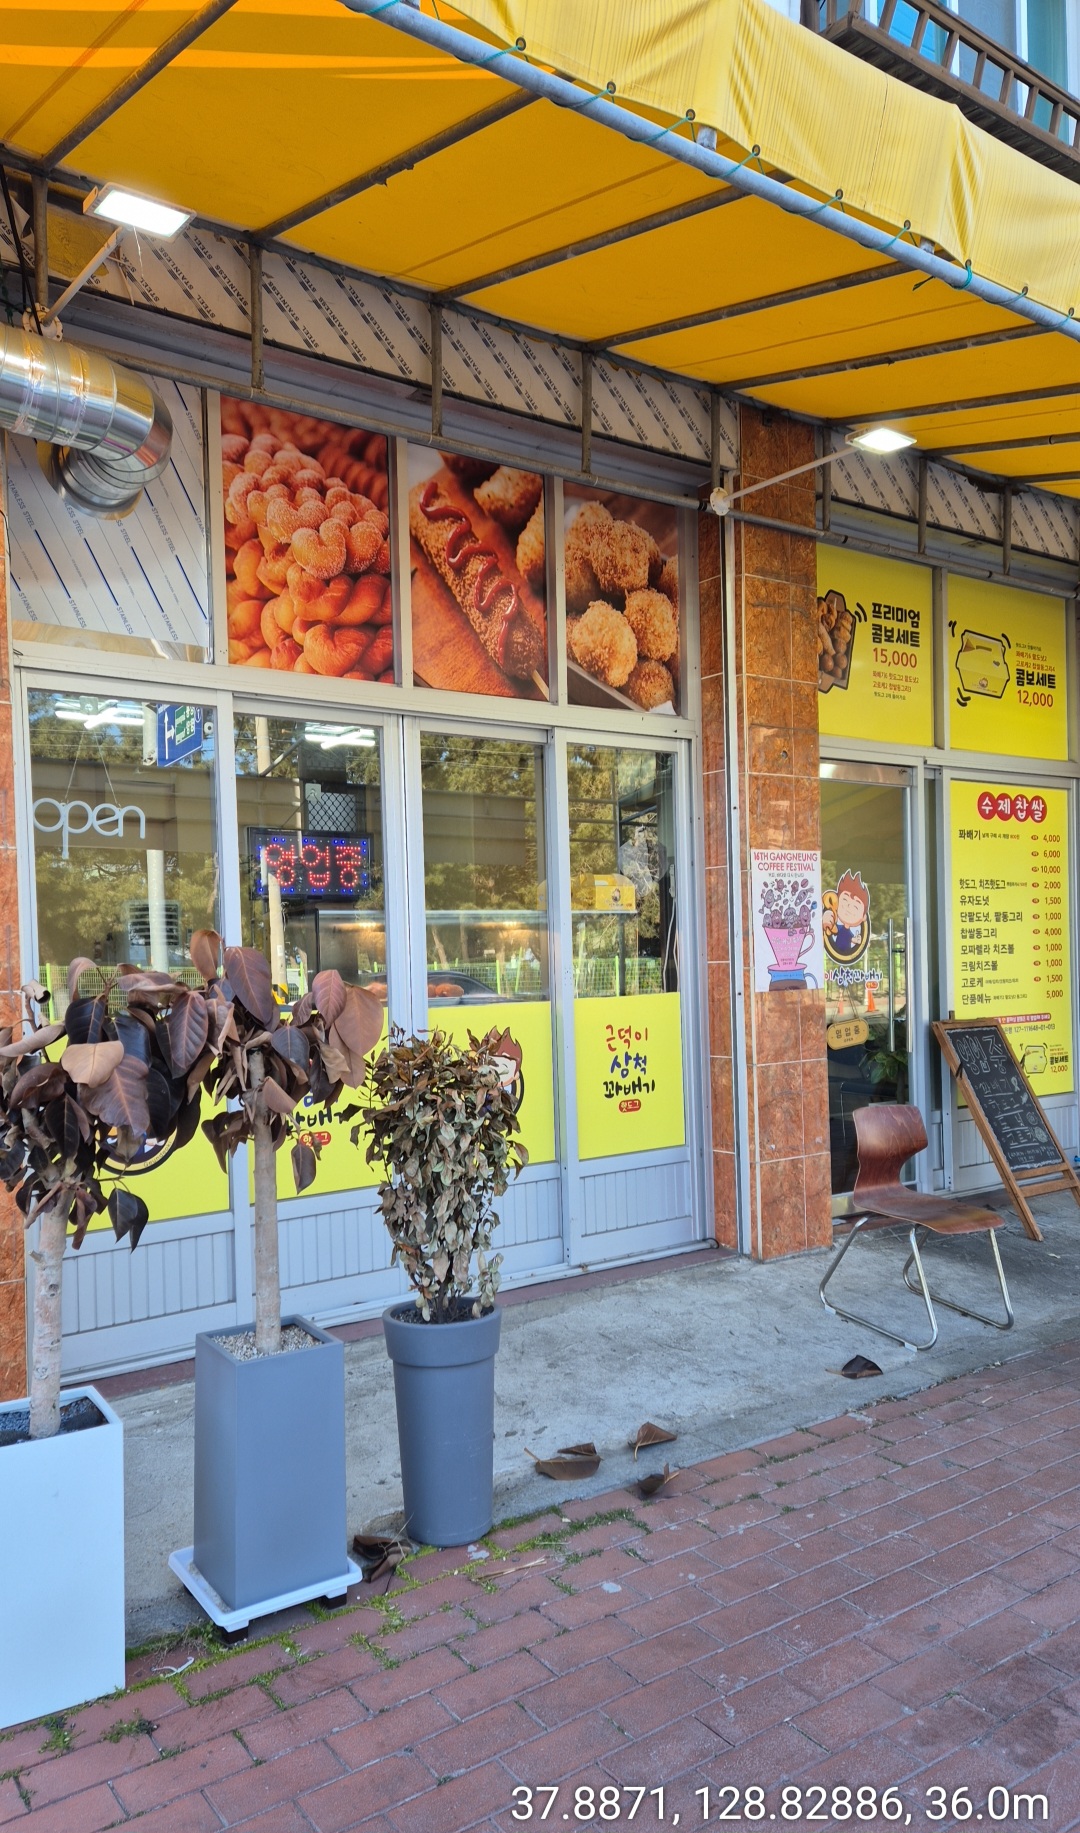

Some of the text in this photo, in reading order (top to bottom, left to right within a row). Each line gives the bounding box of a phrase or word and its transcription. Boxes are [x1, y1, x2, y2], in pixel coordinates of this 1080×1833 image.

[872, 602, 920, 629] 프리미엄
[871, 623, 920, 648] 콤보세트
[873, 647, 917, 668] 15,000
[1015, 668, 1056, 689] 콤보세트
[1017, 689, 1053, 708] 12,000
[33, 797, 145, 860] open
[1043, 834, 1061, 843] 4,000
[753, 851, 818, 862] 16TH GANGNEUNG
[1043, 850, 1061, 859] 6,000
[264, 843, 362, 887] 영업중
[757, 862, 815, 871] COFFEE FESTIVAL
[1041, 865, 1061, 874] 10,000
[979, 878, 1006, 890] 치즈핫도그
[1044, 881, 1061, 890] 2,000
[960, 895, 1062, 906] 유자도넛 1,500
[1044, 912, 1062, 921] 1,000
[960, 927, 1062, 940] 찹쌀동그리 4,000
[992, 943, 1015, 955] 치즈볼
[1045, 943, 1063, 952] 1,000
[960, 958, 1063, 972] 크림치즈볼 1,000
[961, 977, 984, 988] 고로케
[1046, 974, 1063, 983] 1,500
[961, 993, 992, 1005] 단품메뉴
[1046, 990, 1063, 999] 5,000
[605, 1024, 648, 1052] 근덕이
[1050, 1055, 1069, 1065] 콤보세트
[1051, 1064, 1068, 1073] 12,000
[602, 1076, 655, 1099] 꽈배기
